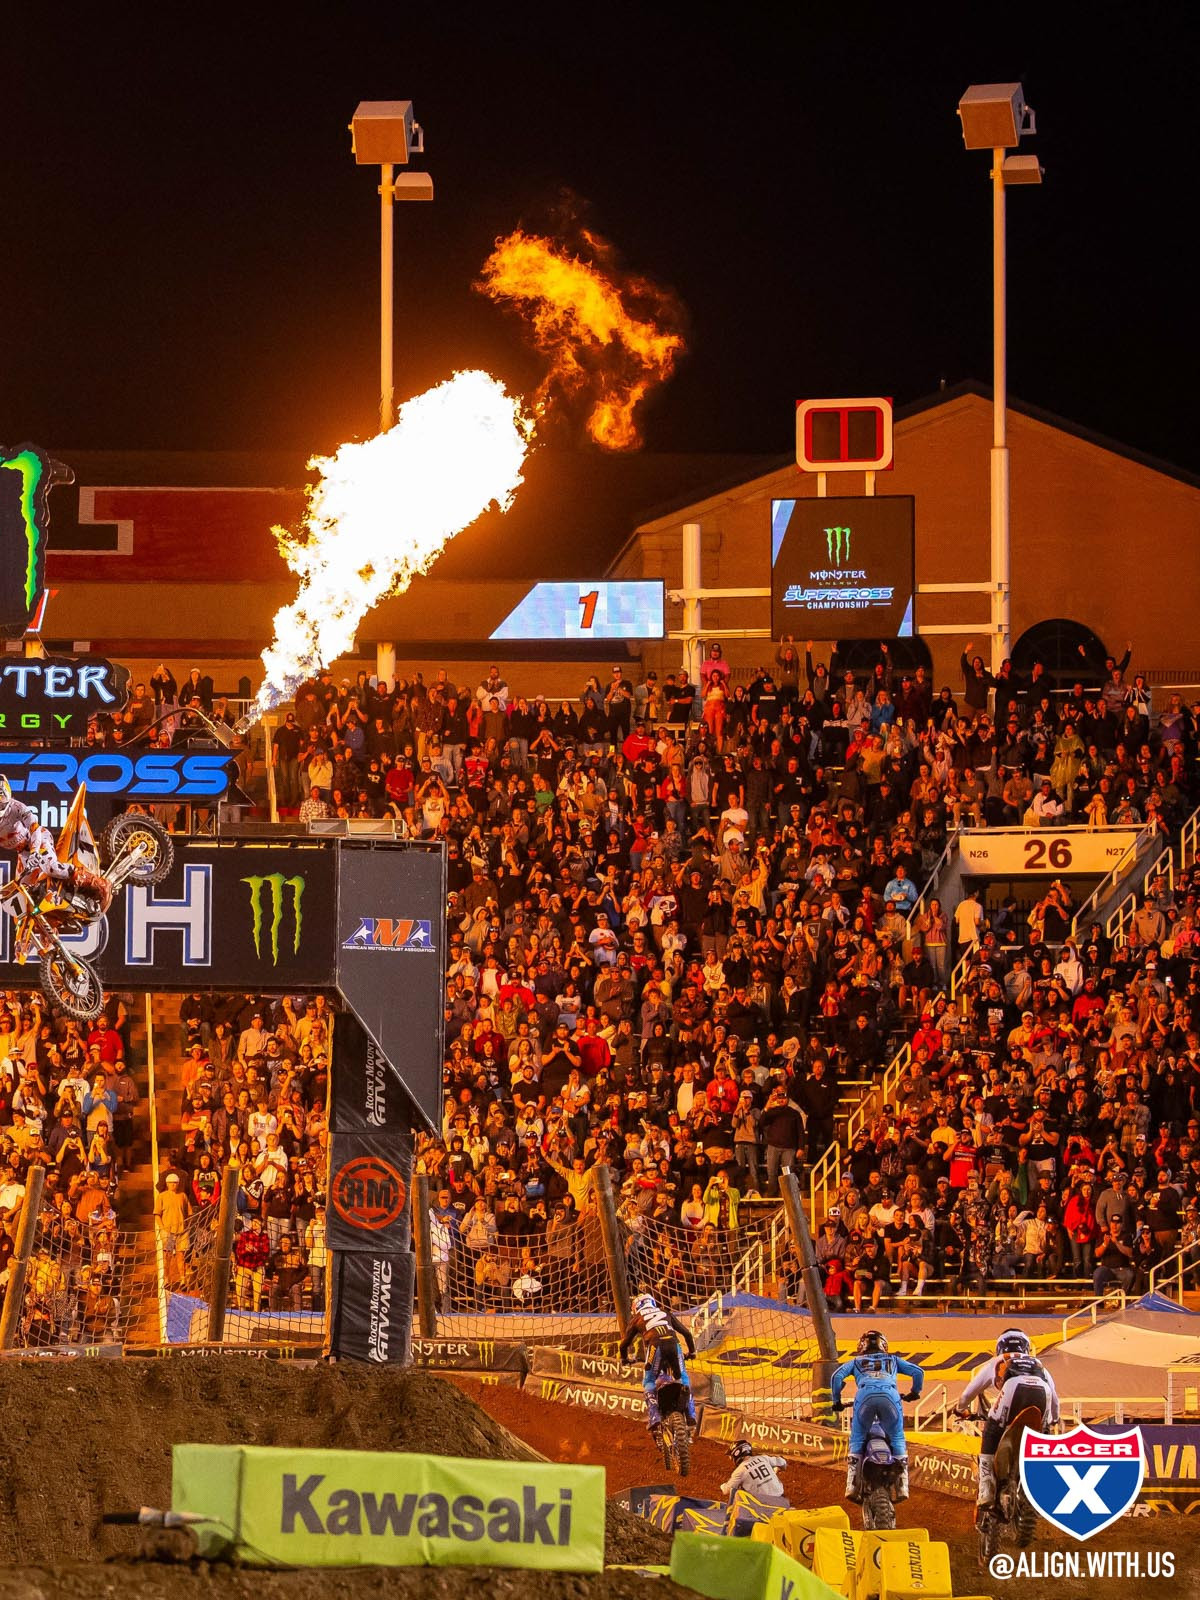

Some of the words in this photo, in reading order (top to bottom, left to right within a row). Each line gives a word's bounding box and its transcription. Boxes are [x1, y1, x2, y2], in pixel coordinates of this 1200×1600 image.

[809, 570, 867, 580] MONSTER
[578, 590, 599, 629] 1
[806, 601, 870, 609] CHAMPIONSHIP
[969, 850, 989, 859] N26
[1023, 838, 1073, 870] 26
[1105, 847, 1126, 856] N27
[341, 917, 437, 949] AMA
[365, 1077, 376, 1111] ROCKY
[348, 1176, 393, 1209] RM
[369, 1259, 382, 1313] MOUNTAIN
[368, 1312, 380, 1346] ROCKY
[643, 1311, 669, 1331] 2
[411, 1341, 471, 1357] NSTER
[417, 1358, 457, 1366] ERGY
[582, 1359, 646, 1379] MONST
[741, 1421, 825, 1450] MONSTER
[749, 1464, 771, 1481] 46
[280, 1473, 573, 1546] Kawasaki
[908, 1541, 924, 1580] DUNLOP
